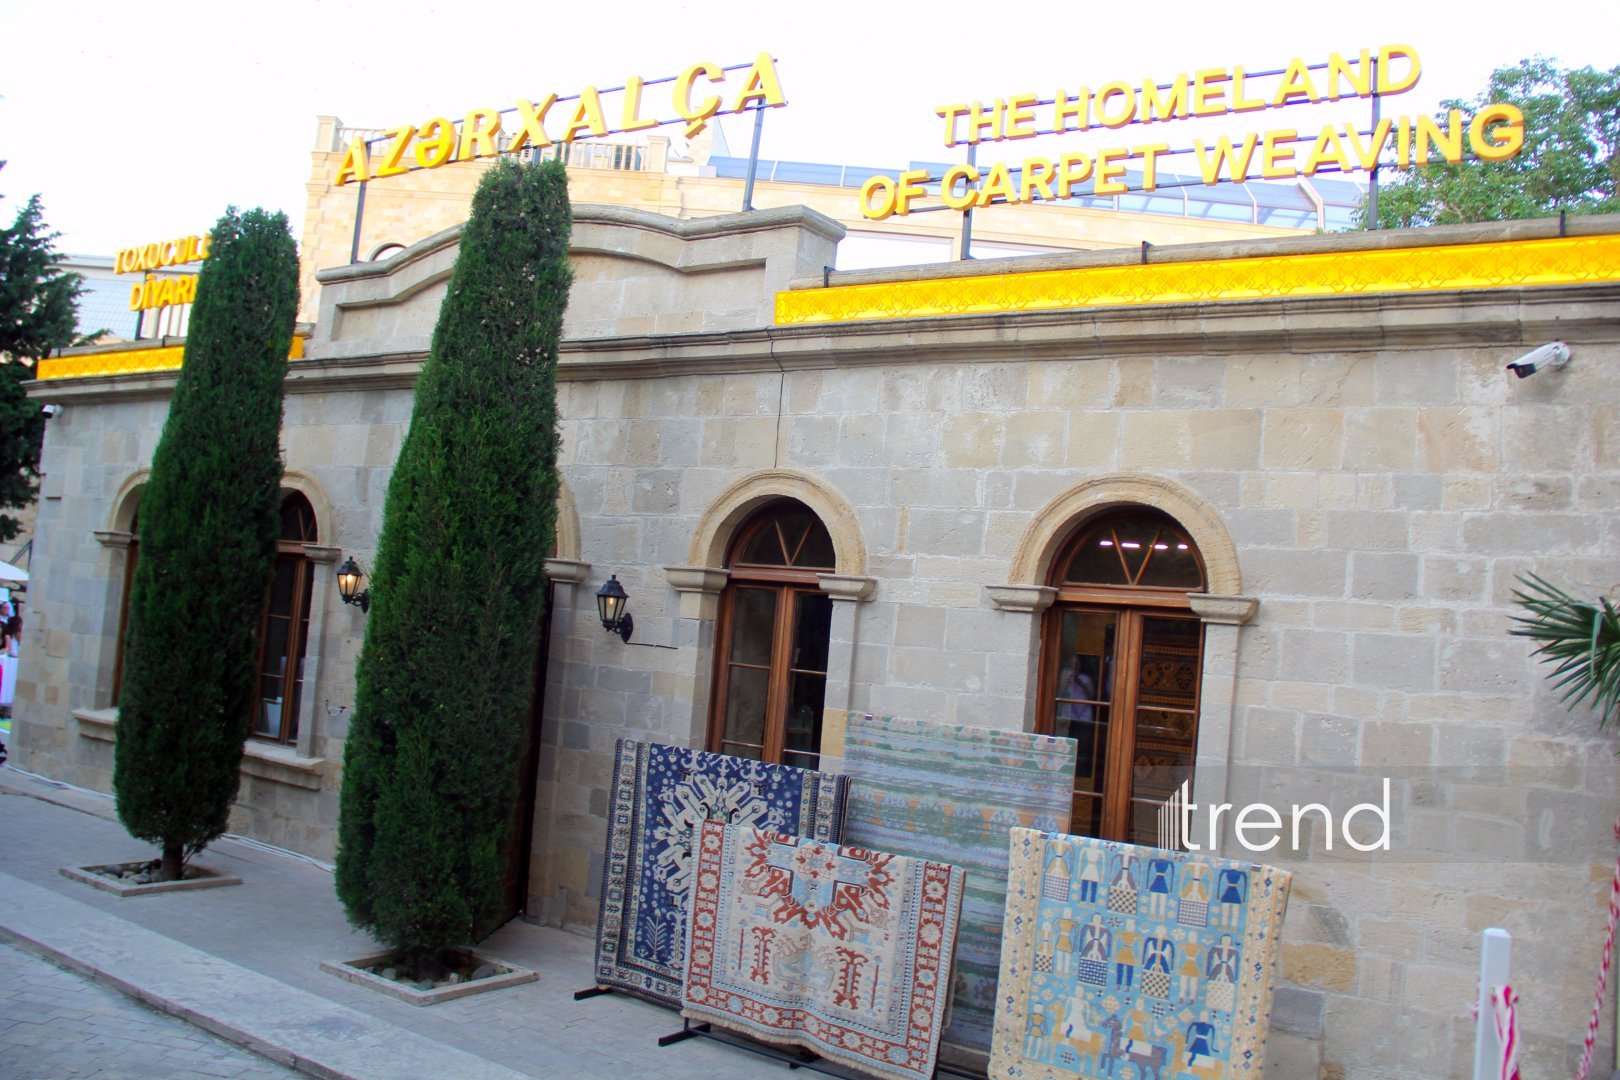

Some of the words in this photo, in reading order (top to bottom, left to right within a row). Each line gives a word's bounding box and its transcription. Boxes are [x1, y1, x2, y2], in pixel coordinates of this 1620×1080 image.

[334, 51, 788, 186] AZƏRXALÇA
[935, 93, 1038, 147] THE
[1053, 44, 1422, 133] HOMELAND
[859, 169, 931, 220] OF
[940, 143, 1170, 211] CARPET
[1193, 103, 1525, 186] WEAVING
